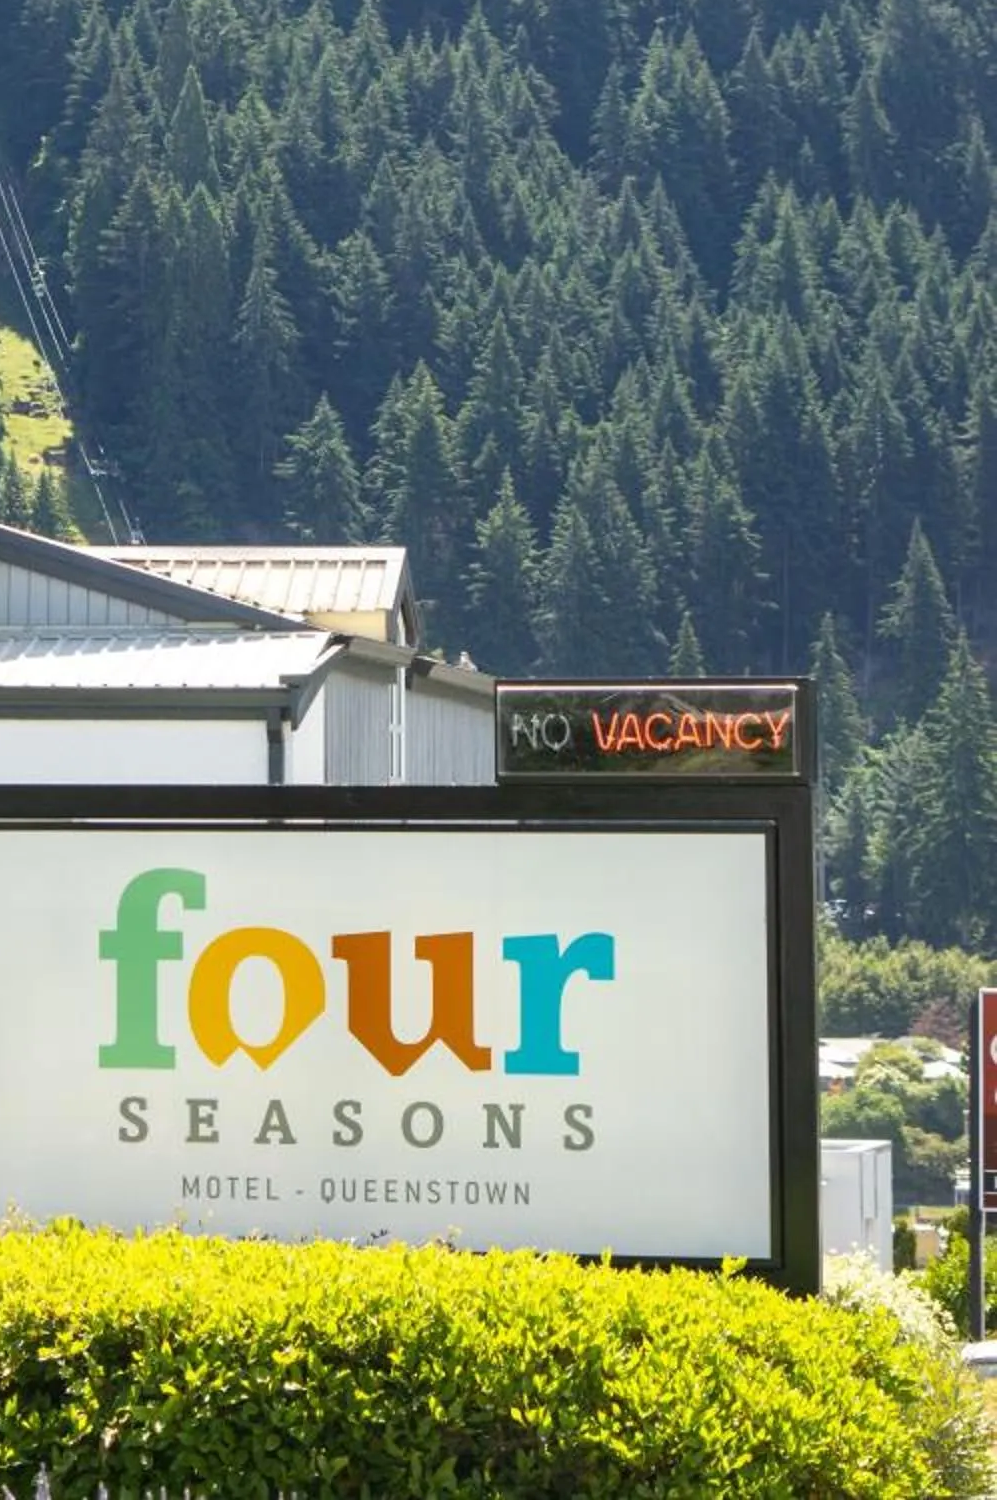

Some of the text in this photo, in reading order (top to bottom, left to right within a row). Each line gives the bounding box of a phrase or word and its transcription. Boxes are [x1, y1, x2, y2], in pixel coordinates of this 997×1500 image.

[511, 711, 791, 751] NO VACANCY
[98, 868, 615, 1077] four
[118, 1097, 595, 1151] SEASONS
[181, 1176, 280, 1202] MOTEL
[320, 1177, 531, 1206] QUEENSTOWN
